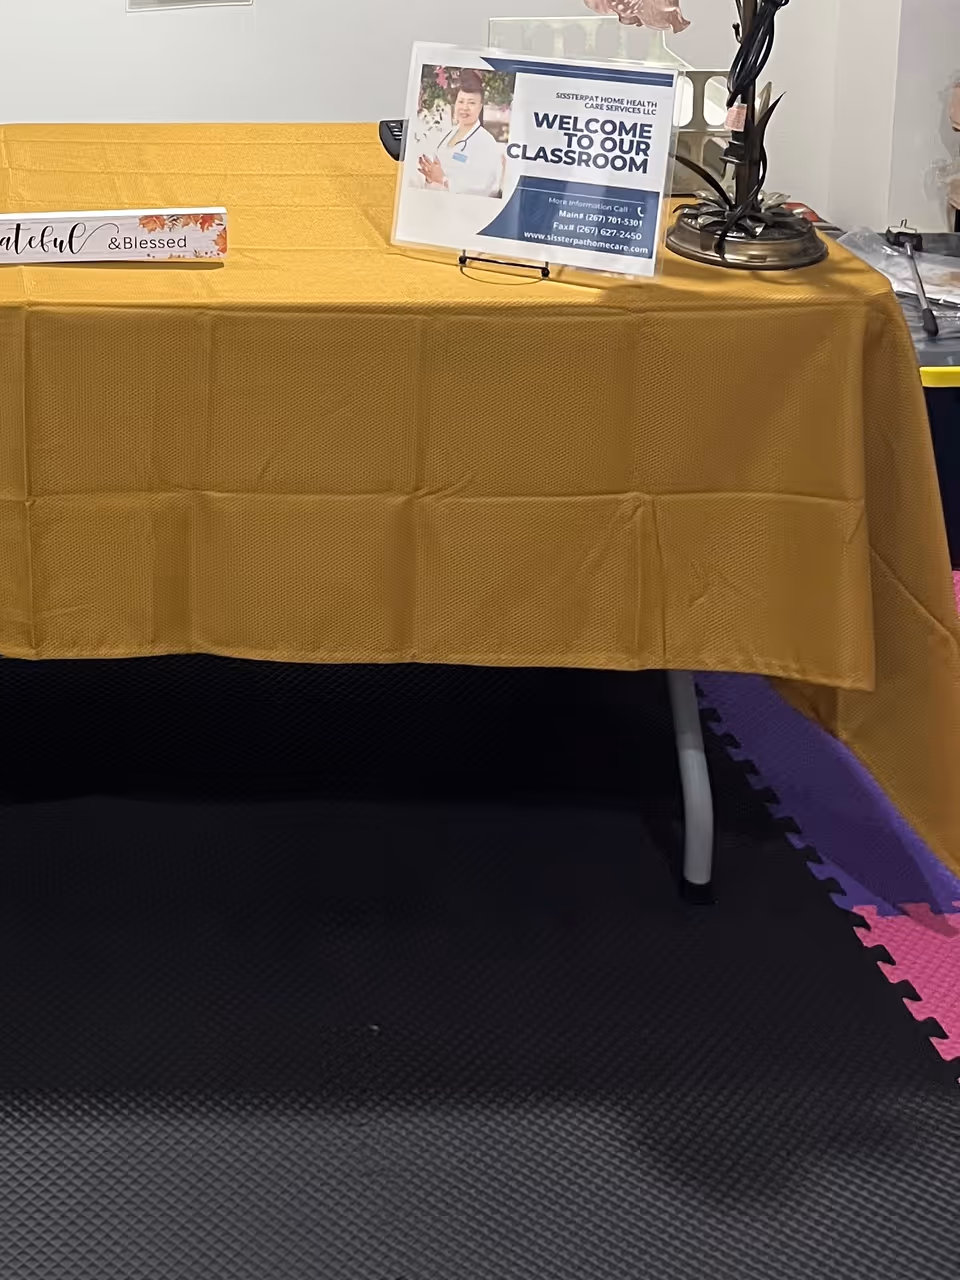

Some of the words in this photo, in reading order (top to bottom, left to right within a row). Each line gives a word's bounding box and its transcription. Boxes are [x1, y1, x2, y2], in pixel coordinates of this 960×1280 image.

[555, 91, 599, 103] SISSTERPAT
[600, 97, 624, 105] HOME
[626, 99, 657, 108] HEALTH
[584, 102, 604, 111] CARE
[605, 104, 641, 114] SERVICES
[642, 108, 657, 116] LLC
[533, 111, 653, 140] WELCOME
[563, 132, 594, 151] TO
[600, 136, 651, 158] OUR
[506, 143, 649, 174] CLASSROOM
[548, 197, 567, 205] More
[568, 200, 612, 211] Information
[613, 205, 628, 213] Call
[558, 209, 584, 220] Main#
[585, 214, 606, 224] (267)
[607, 215, 643, 228] 701-5301
[553, 221, 575, 231] Fax#
[576, 224, 599, 236] (267)
[600, 227, 643, 241] 627-2450
[523, 231, 649, 255] www.sissterpathomecare.com
